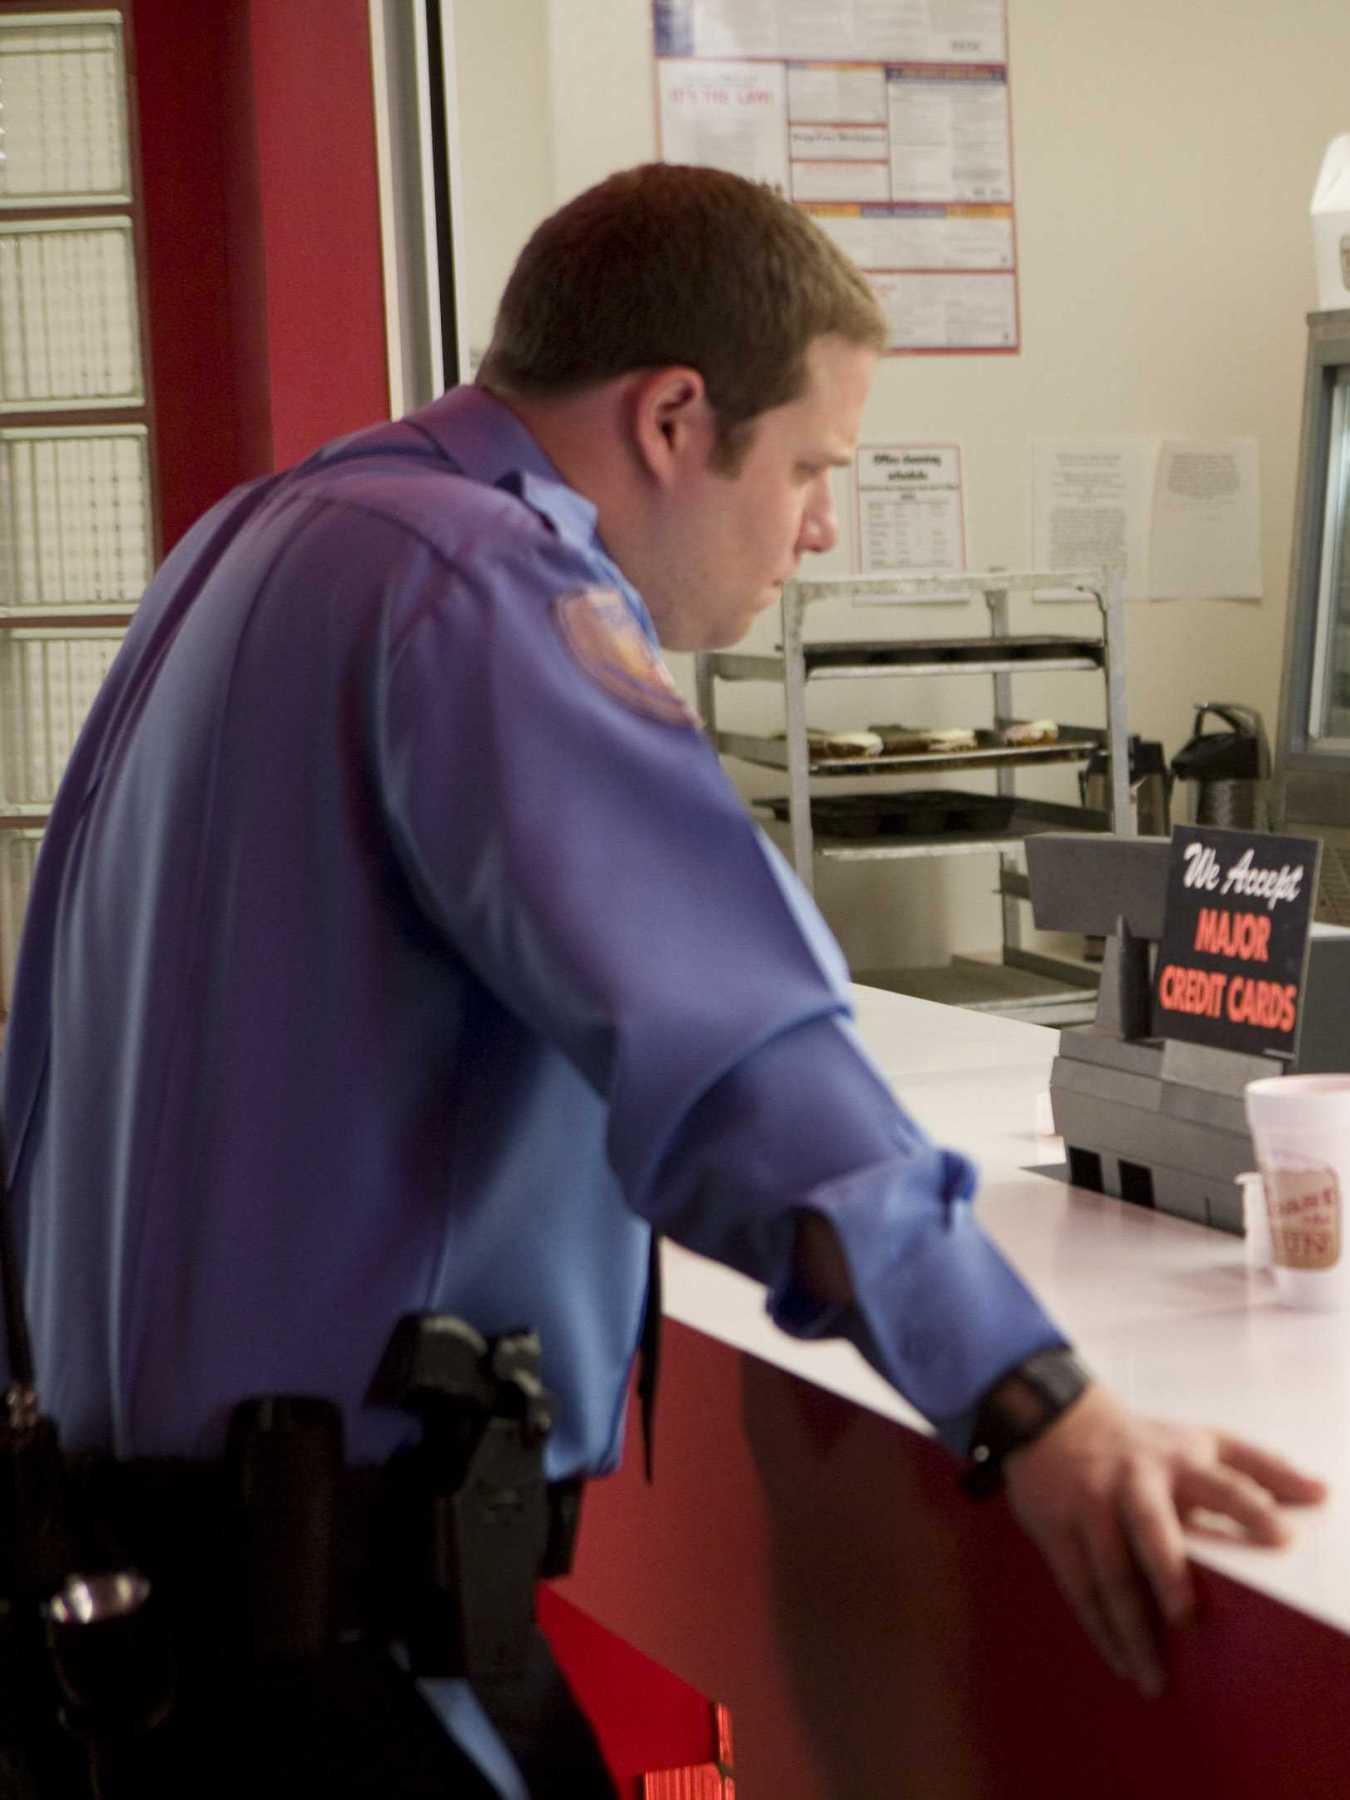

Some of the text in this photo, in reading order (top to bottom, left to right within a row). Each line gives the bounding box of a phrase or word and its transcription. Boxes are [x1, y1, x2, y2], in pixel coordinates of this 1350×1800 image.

[1183, 842, 1304, 911] We Accept
[1194, 908, 1272, 963] MAJOR
[1159, 965, 1298, 1033] CREDIT CARDS
